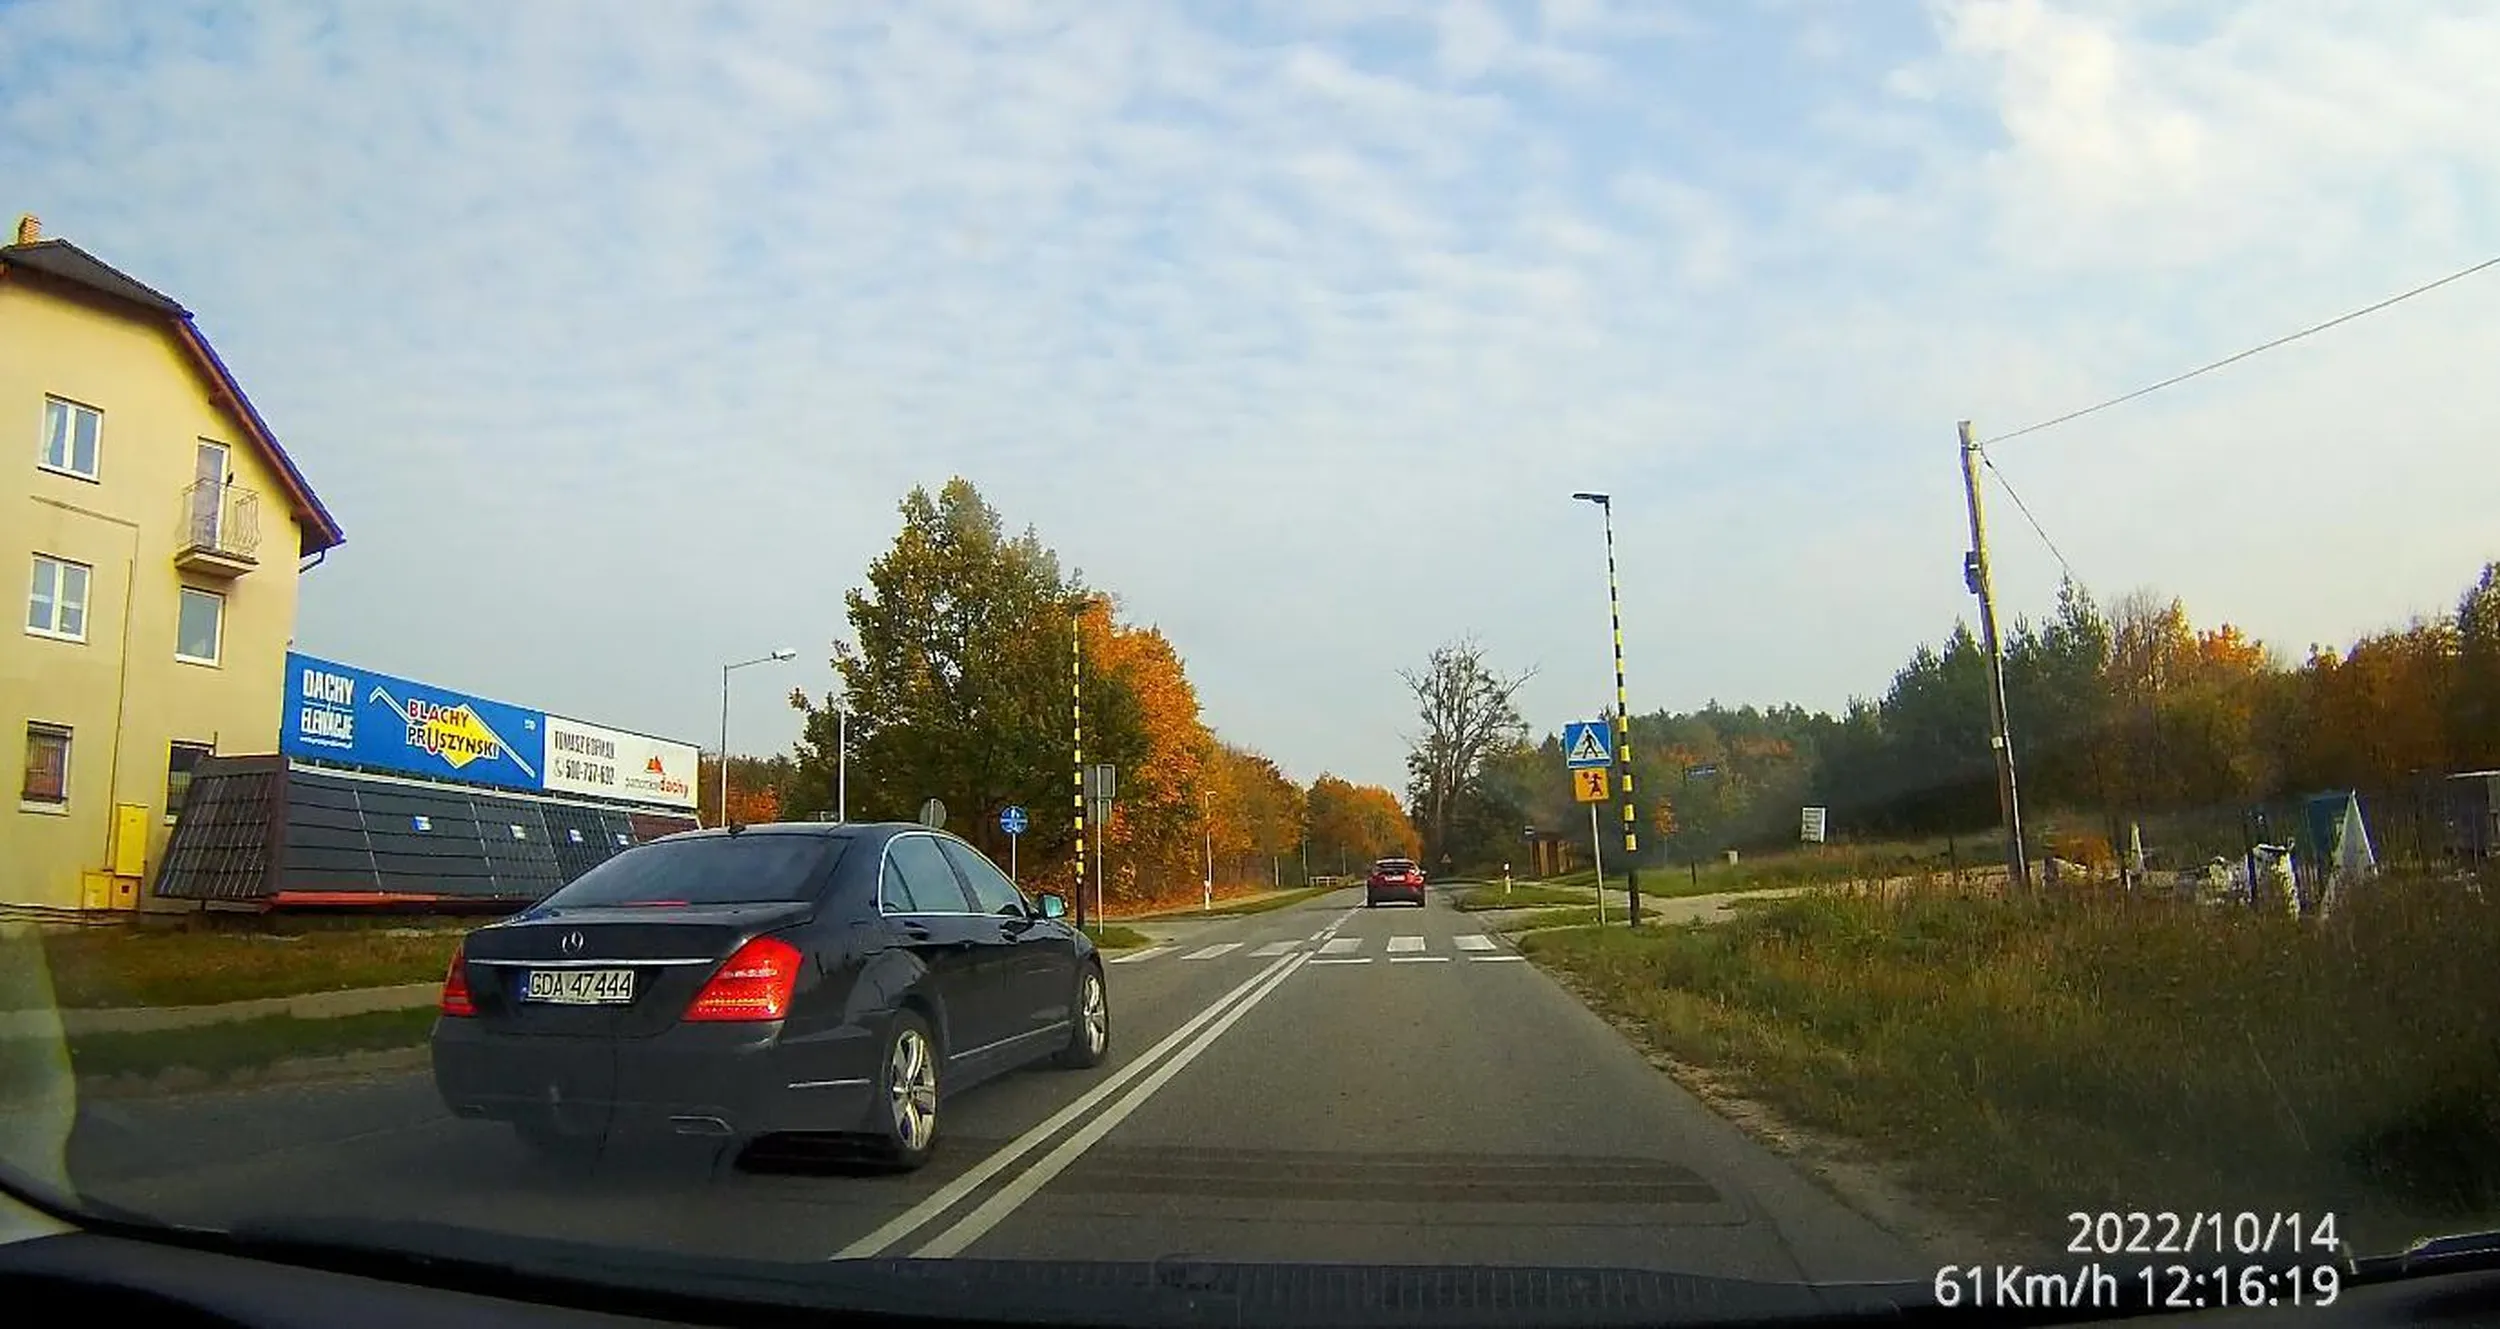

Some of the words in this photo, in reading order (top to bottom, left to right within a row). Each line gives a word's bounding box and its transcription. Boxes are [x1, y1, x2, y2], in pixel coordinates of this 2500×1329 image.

[303, 668, 355, 705] DACHY
[409, 700, 470, 728] BLACHY
[407, 725, 498, 758] PRUSZYŃSKI
[531, 973, 563, 996] GDA
[570, 972, 632, 997] 47444
